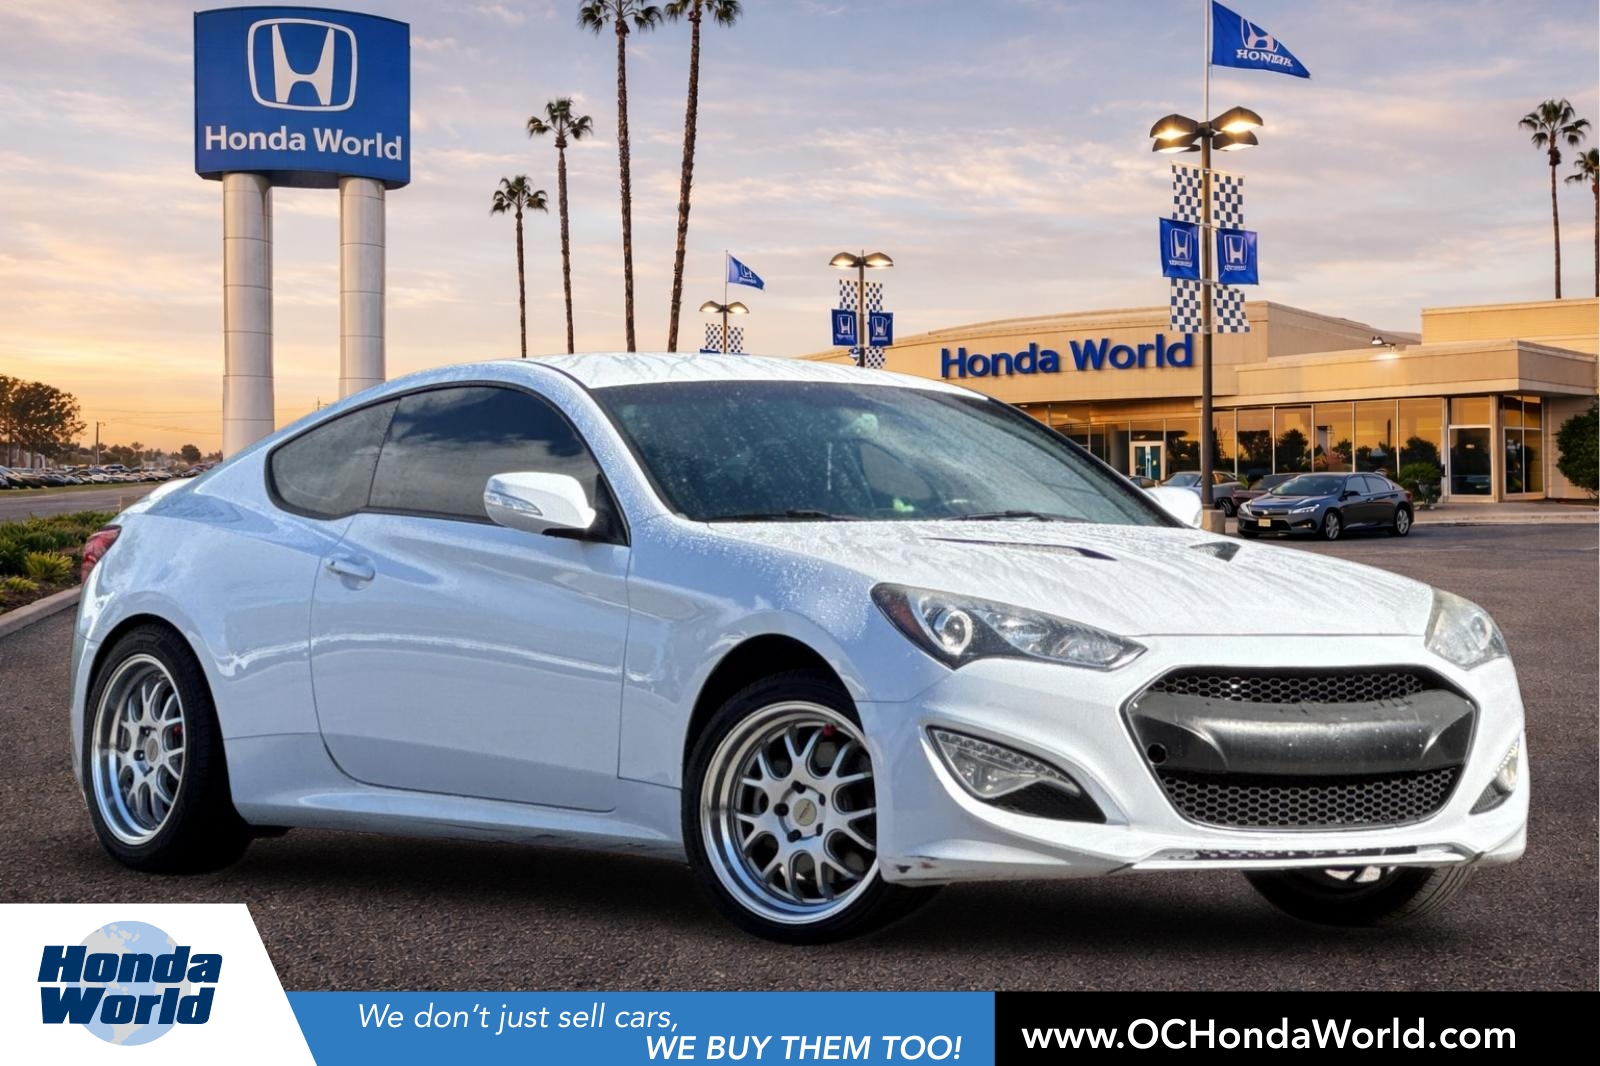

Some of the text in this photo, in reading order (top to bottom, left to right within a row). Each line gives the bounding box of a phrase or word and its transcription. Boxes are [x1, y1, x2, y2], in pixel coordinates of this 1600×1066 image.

[205, 125, 402, 161] Honda World
[941, 333, 1194, 378] Honda World
